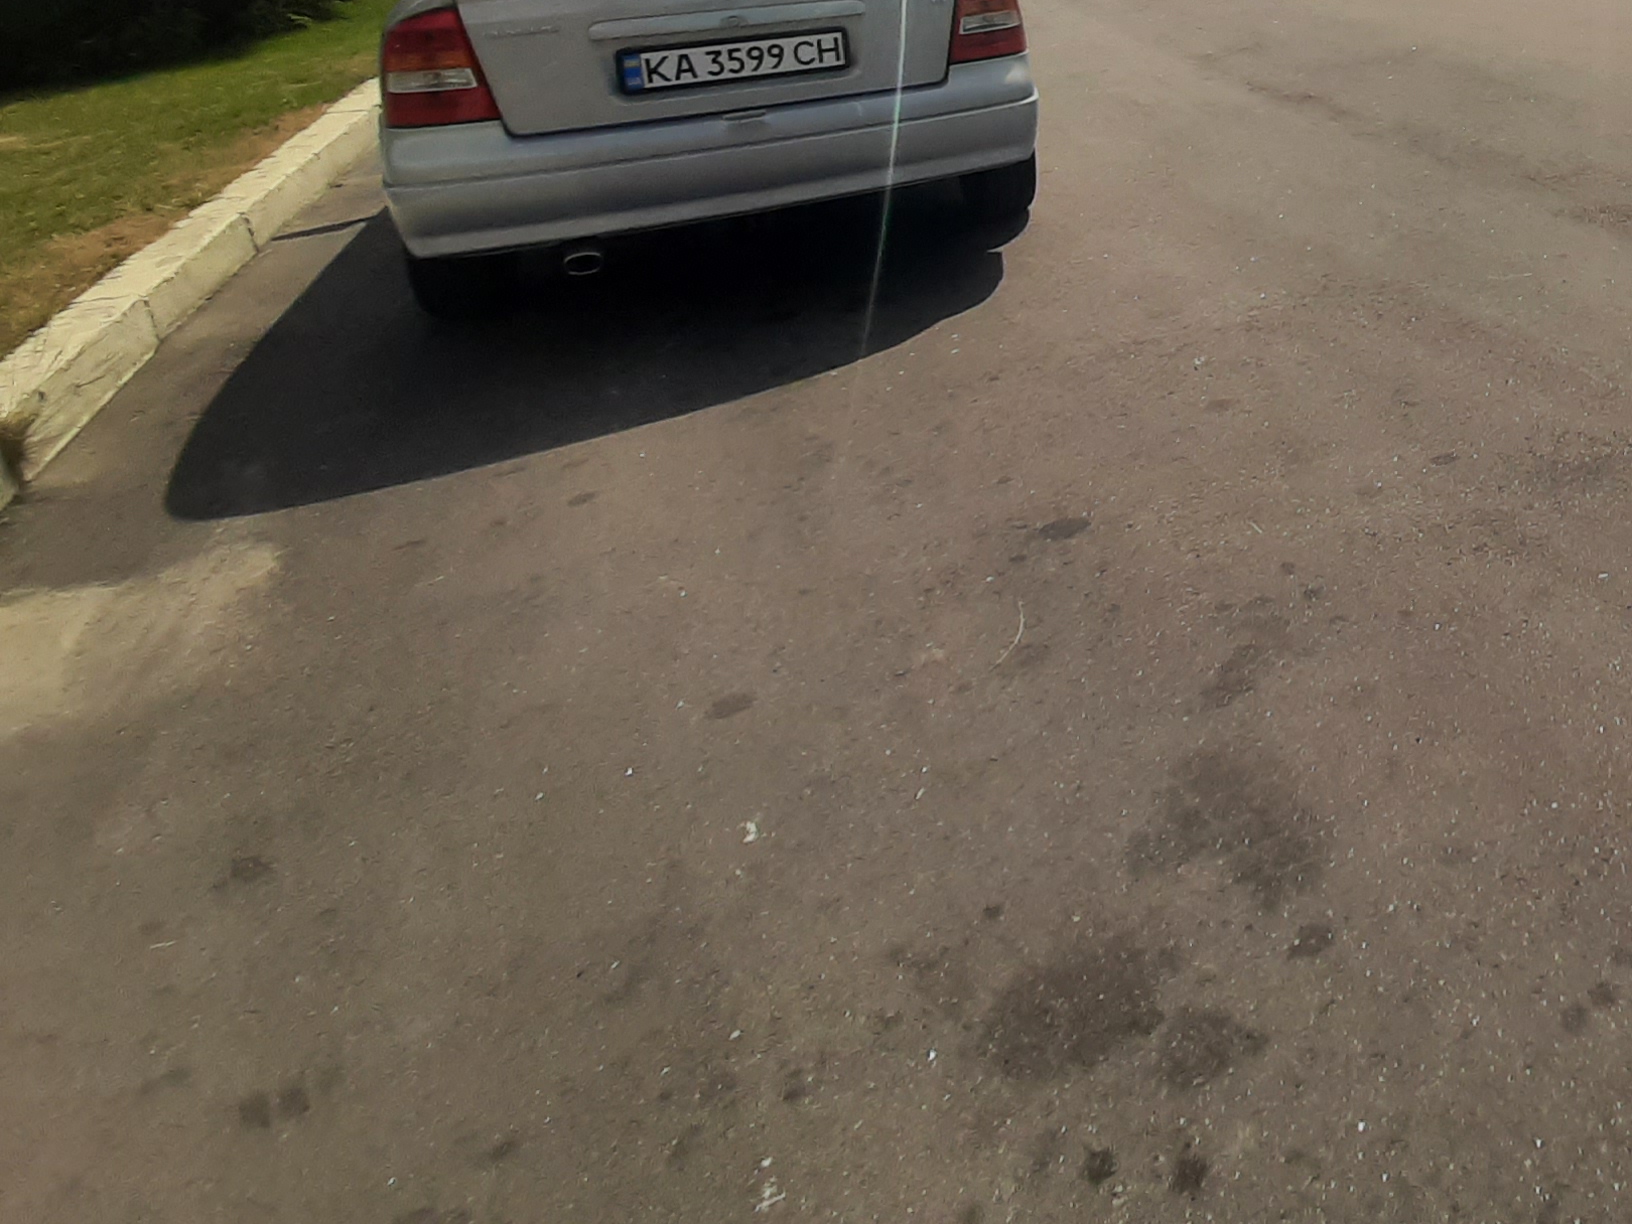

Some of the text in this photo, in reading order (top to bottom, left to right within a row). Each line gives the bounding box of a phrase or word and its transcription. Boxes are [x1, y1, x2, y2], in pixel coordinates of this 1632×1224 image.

[644, 37, 842, 83] KA 3599 CH
